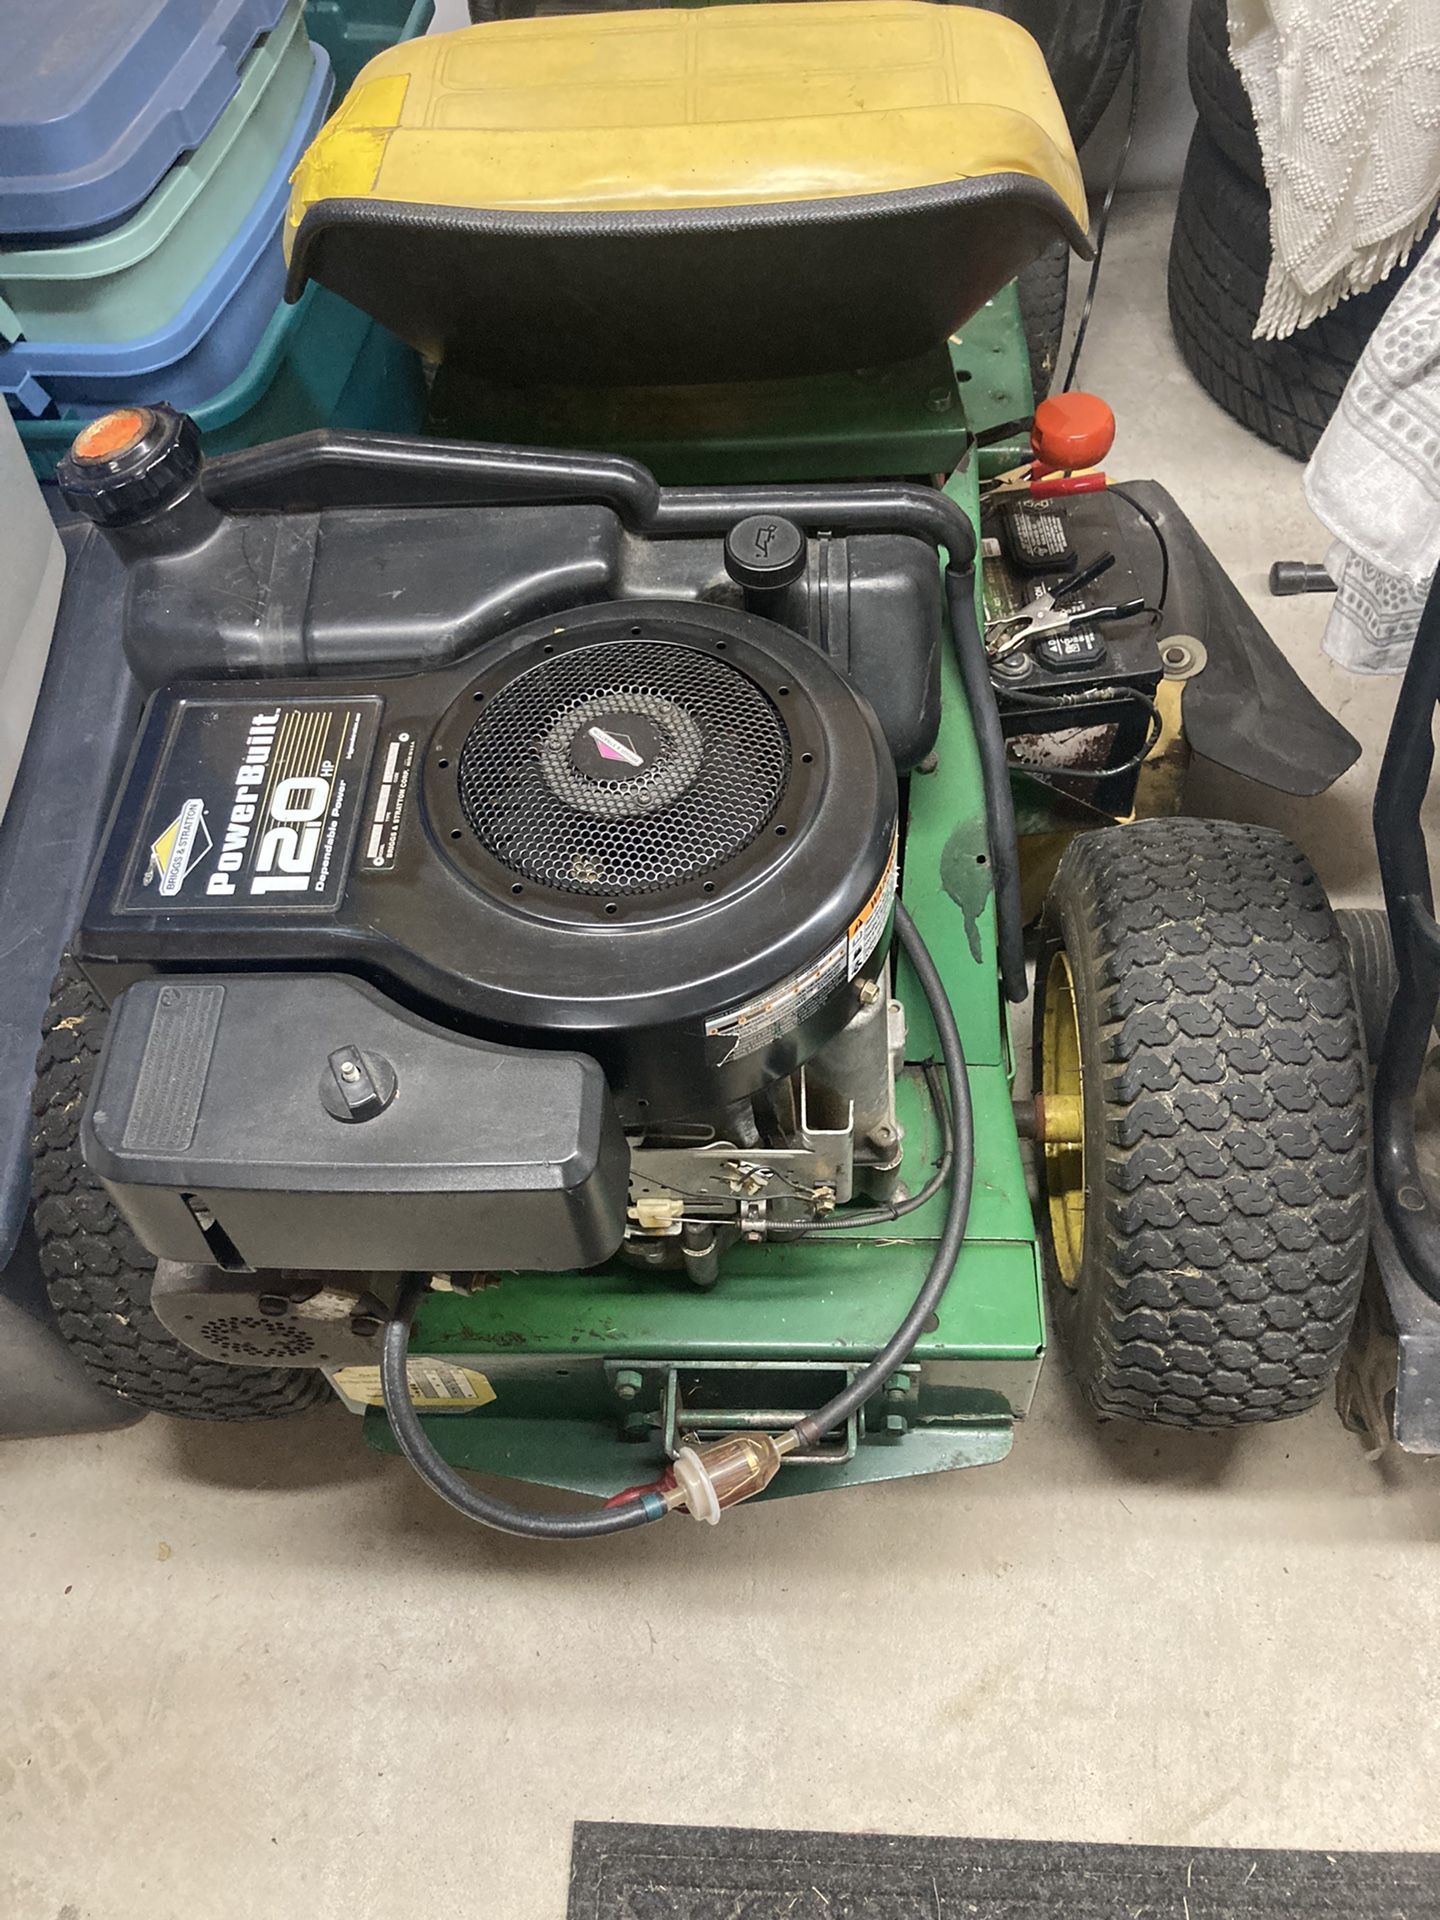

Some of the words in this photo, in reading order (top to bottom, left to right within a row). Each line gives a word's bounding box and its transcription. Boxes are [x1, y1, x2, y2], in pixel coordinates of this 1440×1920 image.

[319, 759, 335, 777] HP
[178, 803, 198, 847] STRATTON
[386, 831, 398, 858] BRIGGS
[392, 788, 406, 824] STRATTON
[400, 768, 411, 789] CORP.
[178, 846, 186, 856] &
[314, 820, 338, 892] Dependable
[330, 779, 347, 818] Power
[166, 855, 183, 890] BRIGGS
